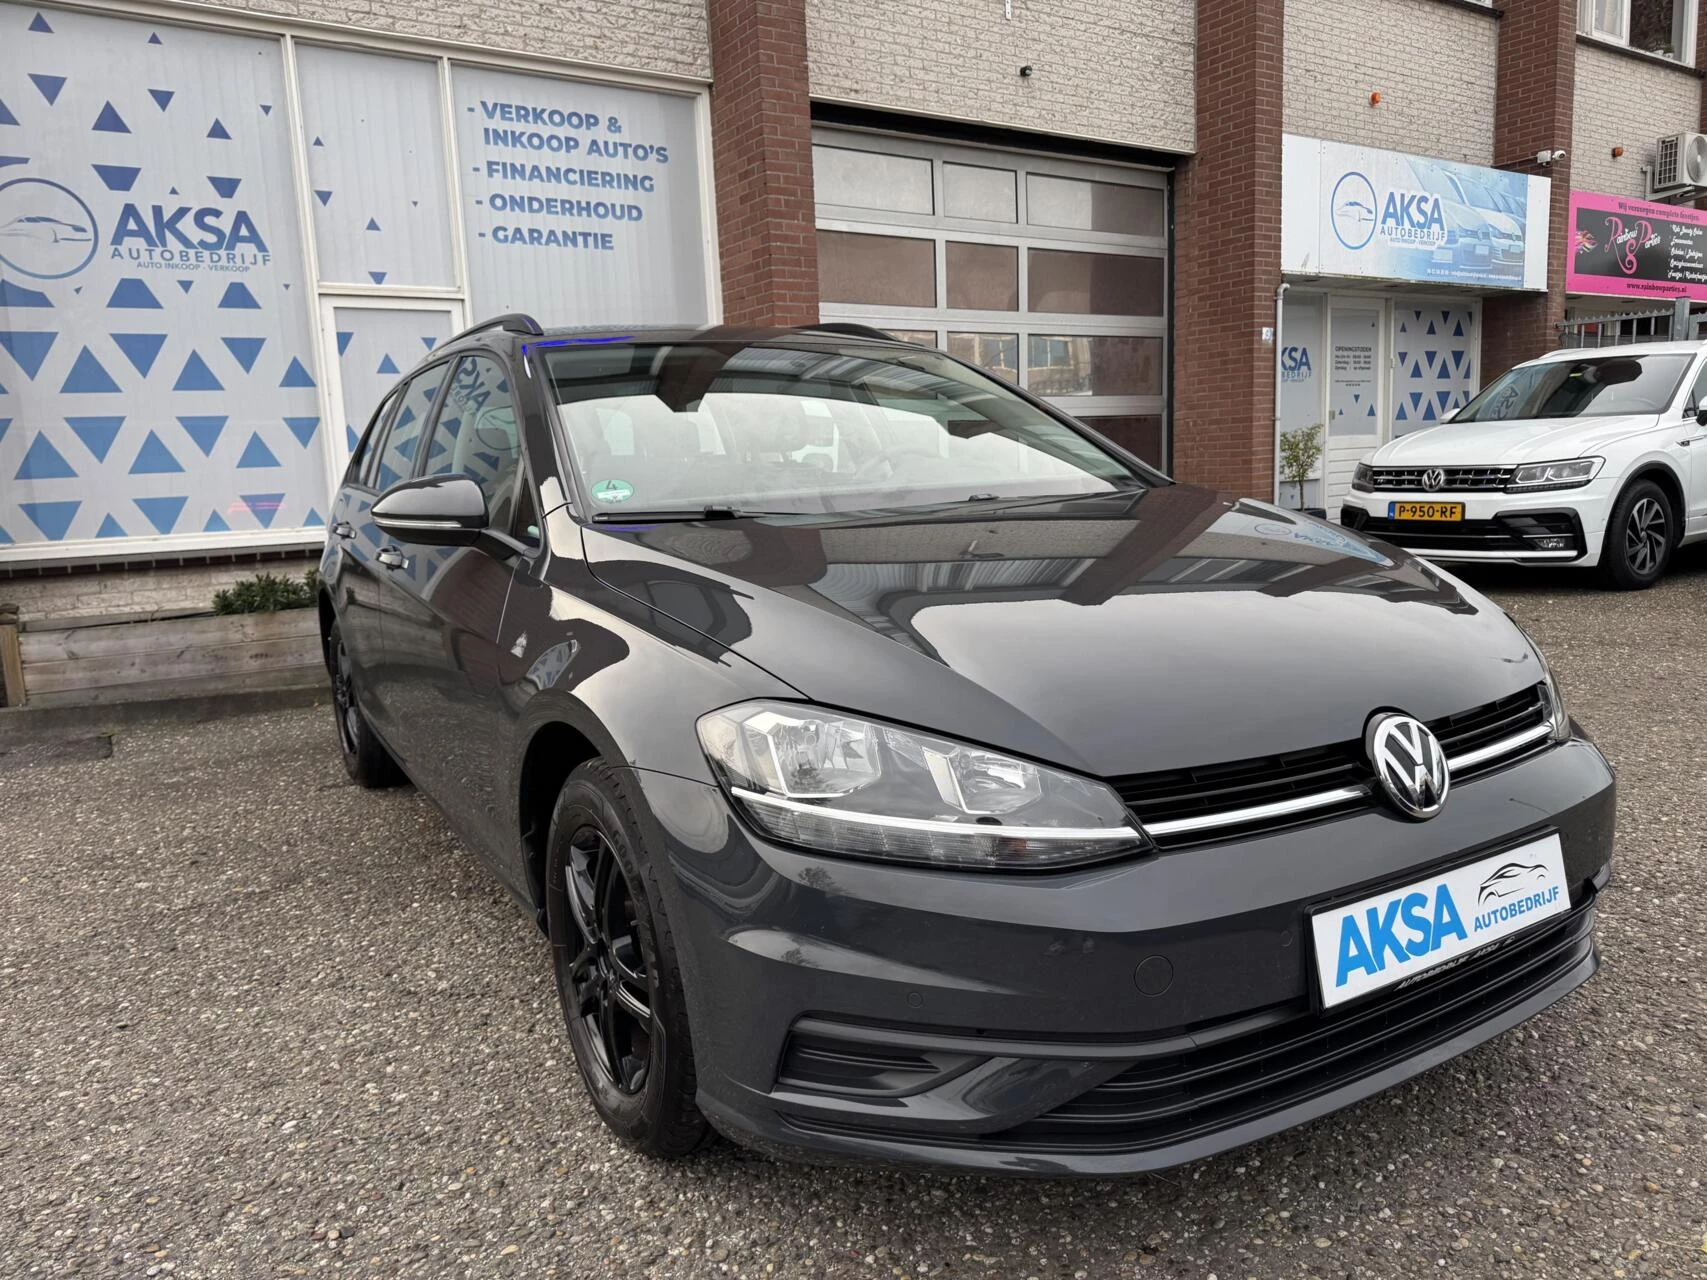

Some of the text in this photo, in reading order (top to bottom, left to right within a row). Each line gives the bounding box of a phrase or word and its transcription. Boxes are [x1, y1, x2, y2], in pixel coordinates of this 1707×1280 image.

[480, 101, 599, 130] VERKOOP
[606, 116, 622, 134] &
[483, 128, 669, 164] INKOOP AUTO'S
[486, 160, 655, 192] FINANCIERING
[489, 193, 643, 222] ONDERHOUD
[1381, 191, 1445, 231] AKSA
[110, 203, 269, 253] AKSA
[491, 225, 615, 251] GARANTIE
[1380, 225, 1445, 241] AUTOBEDRIJF
[110, 247, 271, 266] AUTOBEDRIJF
[136, 261, 163, 270] AUTO
[164, 262, 201, 271] INKOOP
[208, 264, 251, 273] VERKOOP
[1398, 505, 1457, 519] P-950-RF
[1473, 886, 1560, 933] AUTOBEDRIJF
[1335, 883, 1468, 988] AKSA
